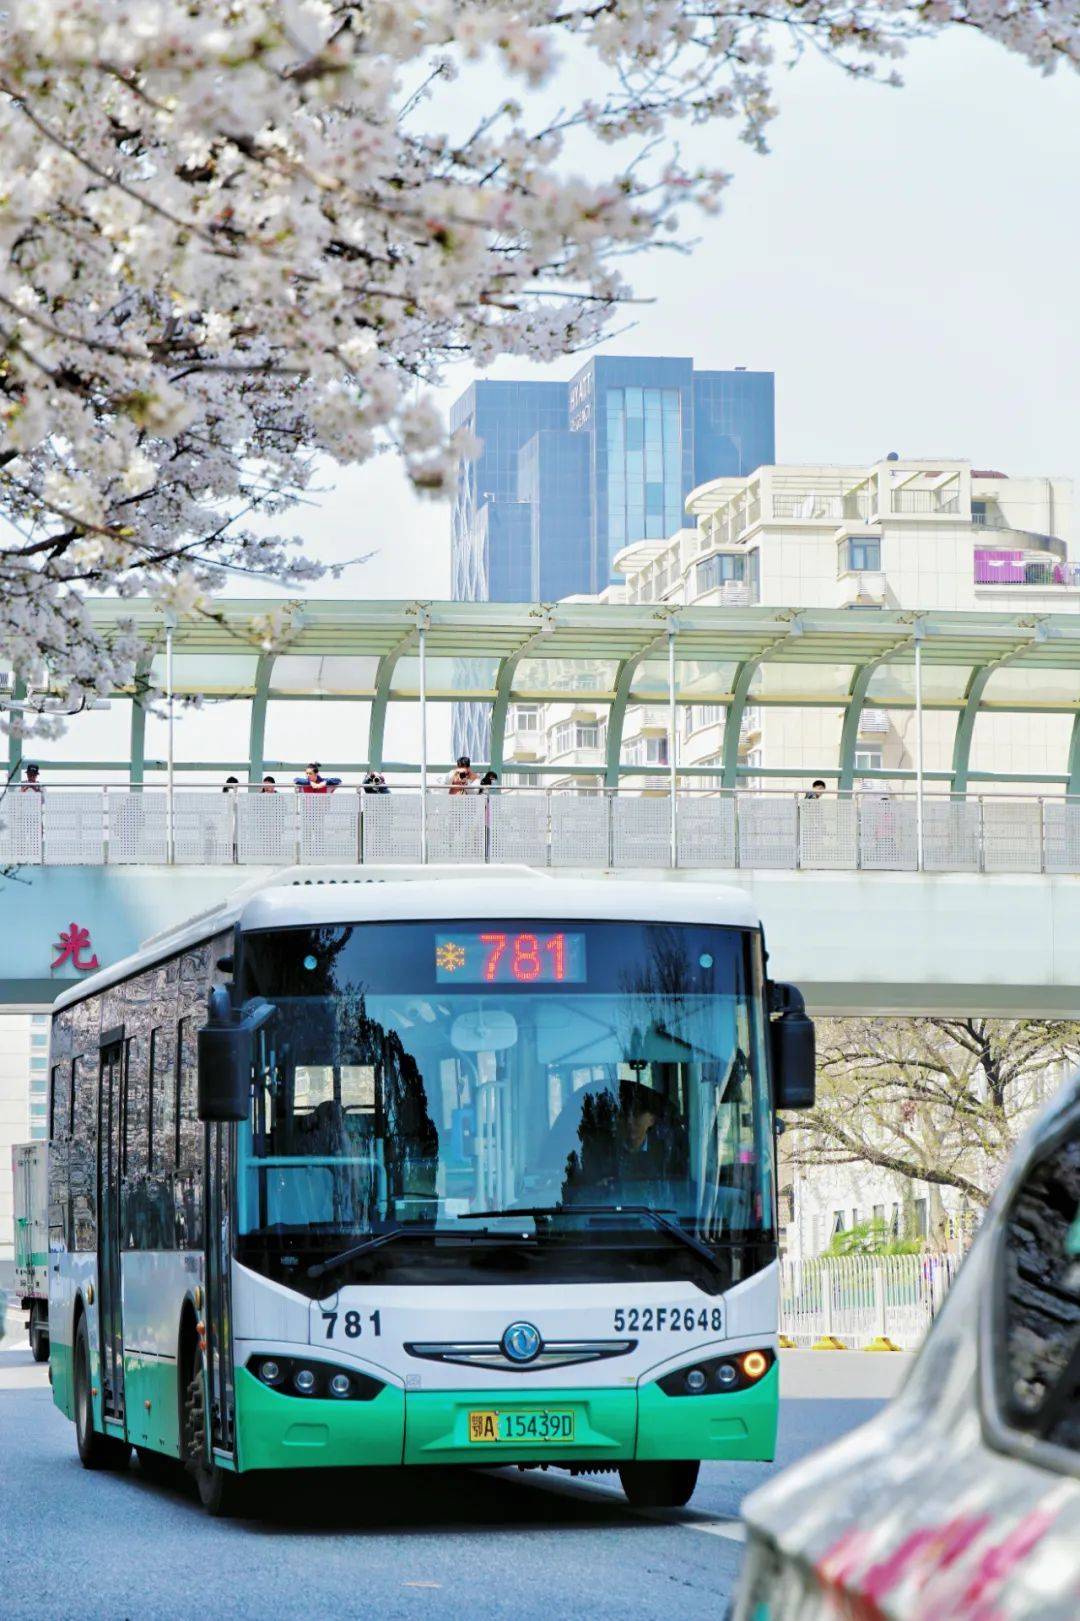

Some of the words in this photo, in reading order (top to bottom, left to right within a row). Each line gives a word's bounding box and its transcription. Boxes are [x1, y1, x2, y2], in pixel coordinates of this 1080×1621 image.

[51, 922, 99, 970] 光
[480, 933, 564, 980] 781
[322, 1309, 380, 1338] 781
[614, 1308, 722, 1331] 522F2648
